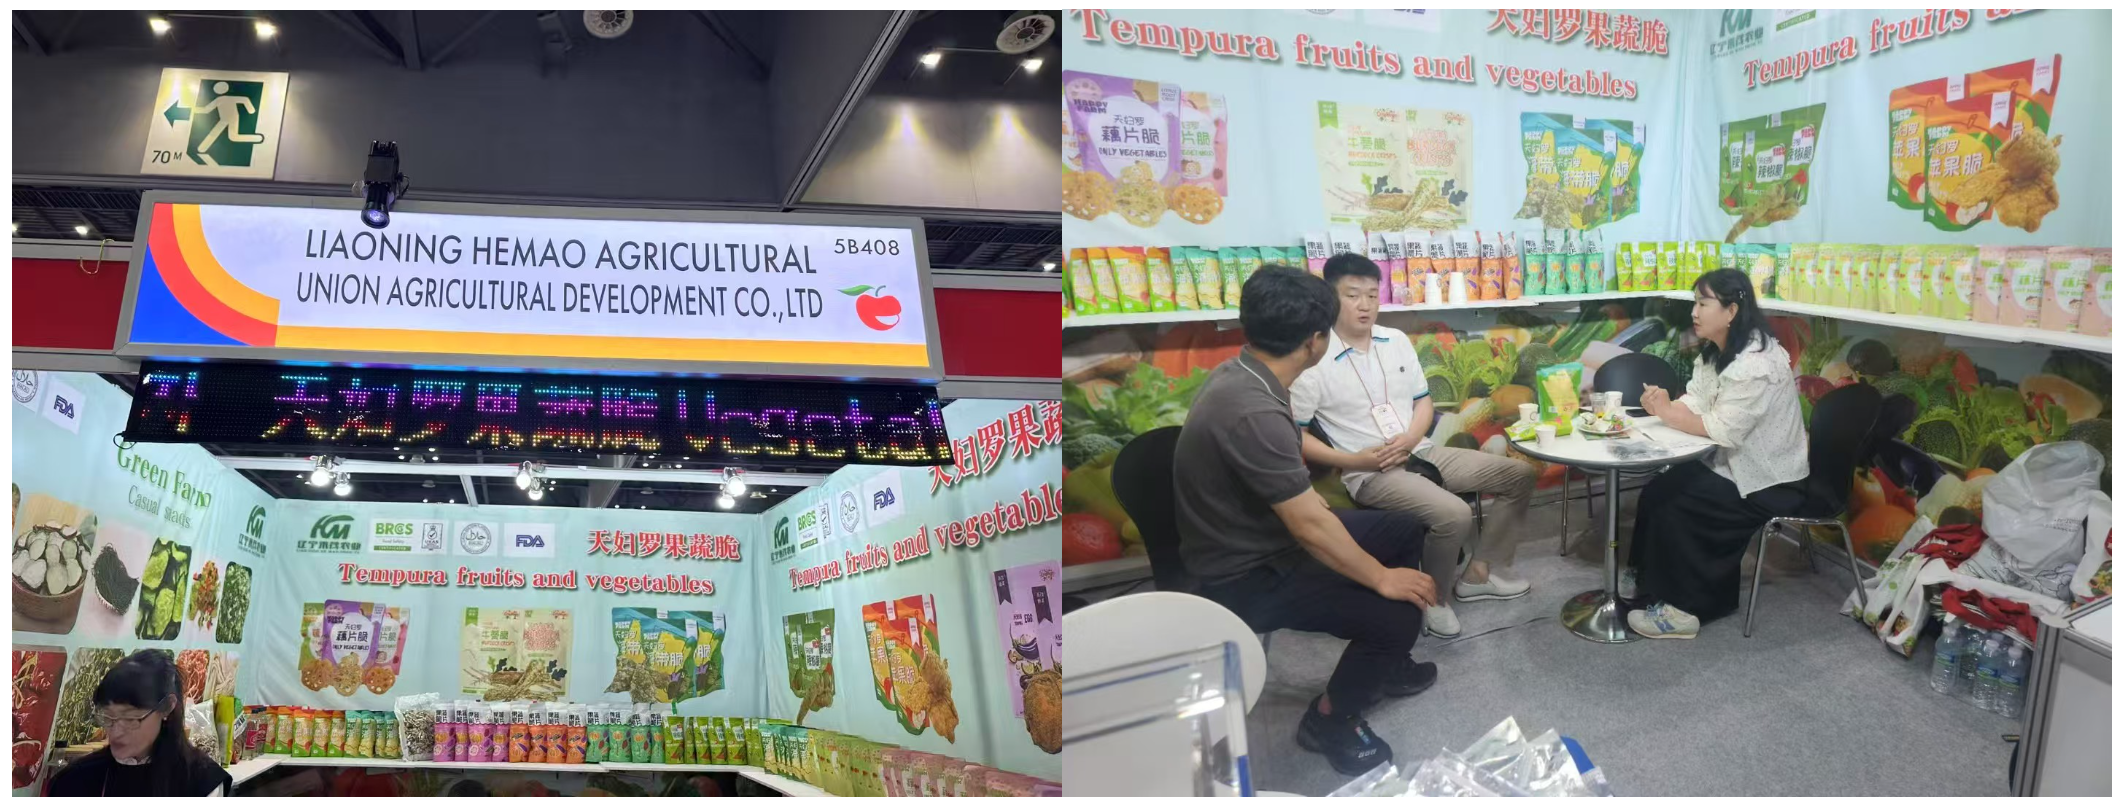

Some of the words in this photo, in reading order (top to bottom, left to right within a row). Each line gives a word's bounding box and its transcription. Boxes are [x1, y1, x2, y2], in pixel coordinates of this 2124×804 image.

[1486, 9, 1669, 54] 天妇罗果蔬脆
[1070, 9, 1278, 60] Tempura
[1294, 33, 1401, 75] fruits
[1413, 55, 1474, 83] and
[1485, 63, 1637, 98] vegetables
[1743, 34, 1857, 88] Tempura
[1867, 9, 1973, 54] fruits
[152, 150, 170, 163] 70
[305, 229, 462, 265] LIAONING
[474, 236, 586, 270] HEMAO
[595, 239, 817, 274] AGRICULTURAL
[834, 238, 900, 256] 5B408
[297, 271, 379, 305] UNION
[387, 277, 556, 312] AGRICULTURAL
[563, 281, 727, 318] DEVELOPMENT
[734, 286, 823, 323] CO.,LTD
[53, 394, 75, 420] FDA
[117, 441, 168, 490] Green
[128, 484, 160, 516] Casual
[873, 487, 896, 511] FDA
[515, 534, 545, 548] FDA
[587, 529, 741, 560] 天妇罗果蔬脆
[845, 543, 889, 575] fruits
[893, 524, 930, 562] and
[339, 563, 446, 586] Tempura
[456, 566, 525, 587] fruits
[532, 569, 576, 588] and
[585, 573, 713, 594] vegetables
